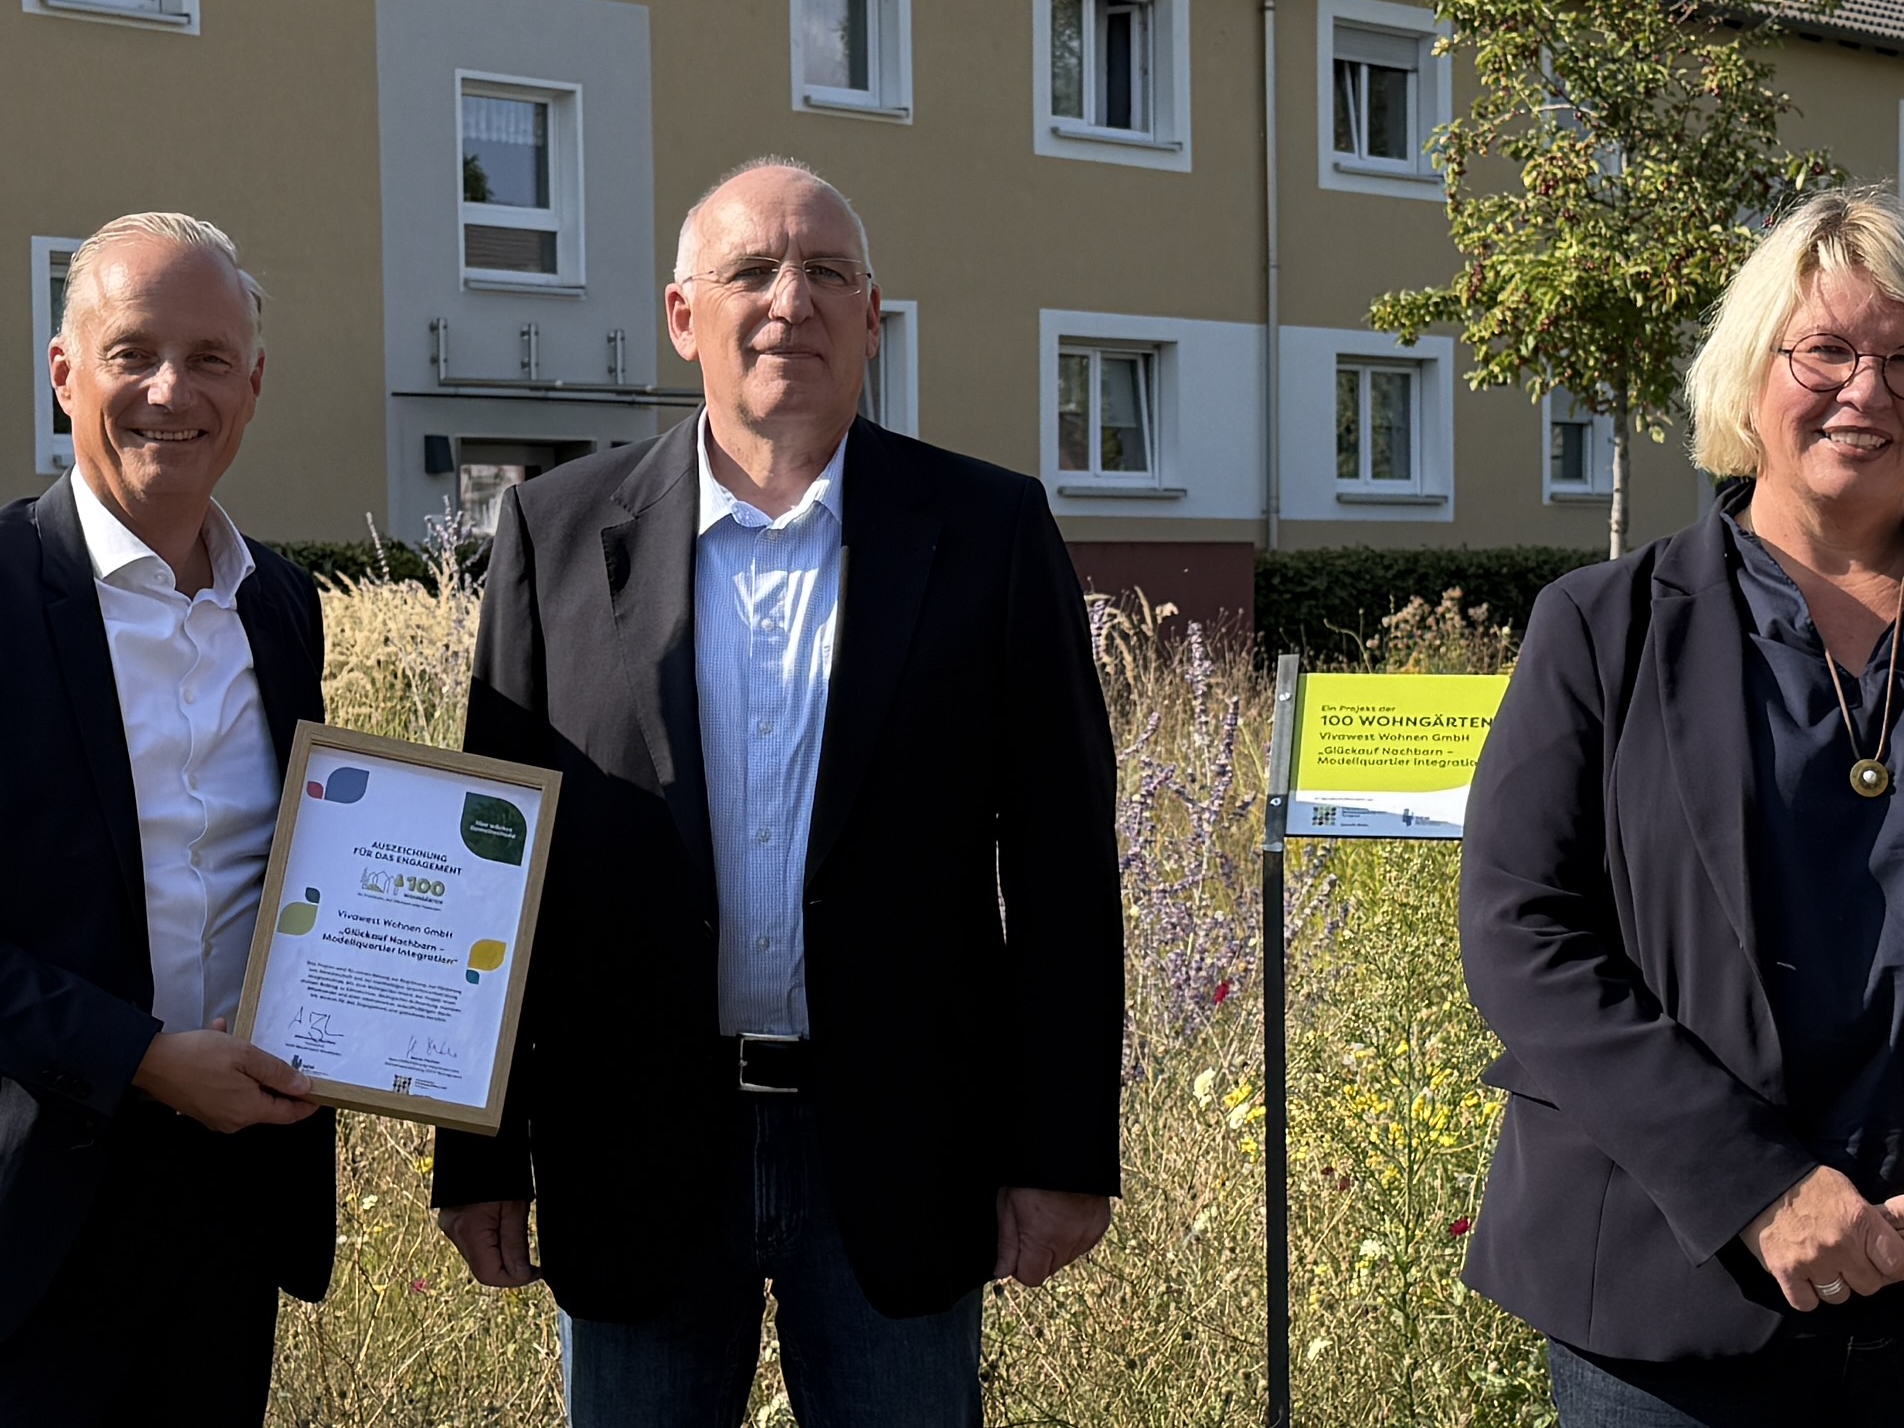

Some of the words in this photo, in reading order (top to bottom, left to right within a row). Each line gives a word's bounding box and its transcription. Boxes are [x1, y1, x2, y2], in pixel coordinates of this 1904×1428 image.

[1321, 704, 1337, 713] Ein
[1339, 704, 1376, 715] Projekt
[1378, 704, 1396, 713] der
[1321, 715, 1354, 727] 100
[1358, 713, 1493, 729] WOHNGÄRTEN
[1319, 731, 1376, 742] Vivawest
[1379, 732, 1429, 742] Wohnen
[1432, 733, 1471, 743] GmbH
[1382, 747, 1444, 757] Nachbarn
[1317, 757, 1410, 768] Modellquartier
[1413, 758, 1477, 769] Integratio
[371, 841, 448, 863] AUSZEICHNUNG
[353, 846, 373, 859] FÜR
[375, 851, 394, 863] DAS
[396, 856, 463, 876] ENGAGEMENT
[406, 875, 446, 898] 100
[337, 909, 381, 926] Vivawest
[383, 917, 422, 933] Wohnen
[423, 926, 454, 940] GmbH
[321, 932, 396, 954] Modellquartier
[389, 935, 437, 952] Nachbarn
